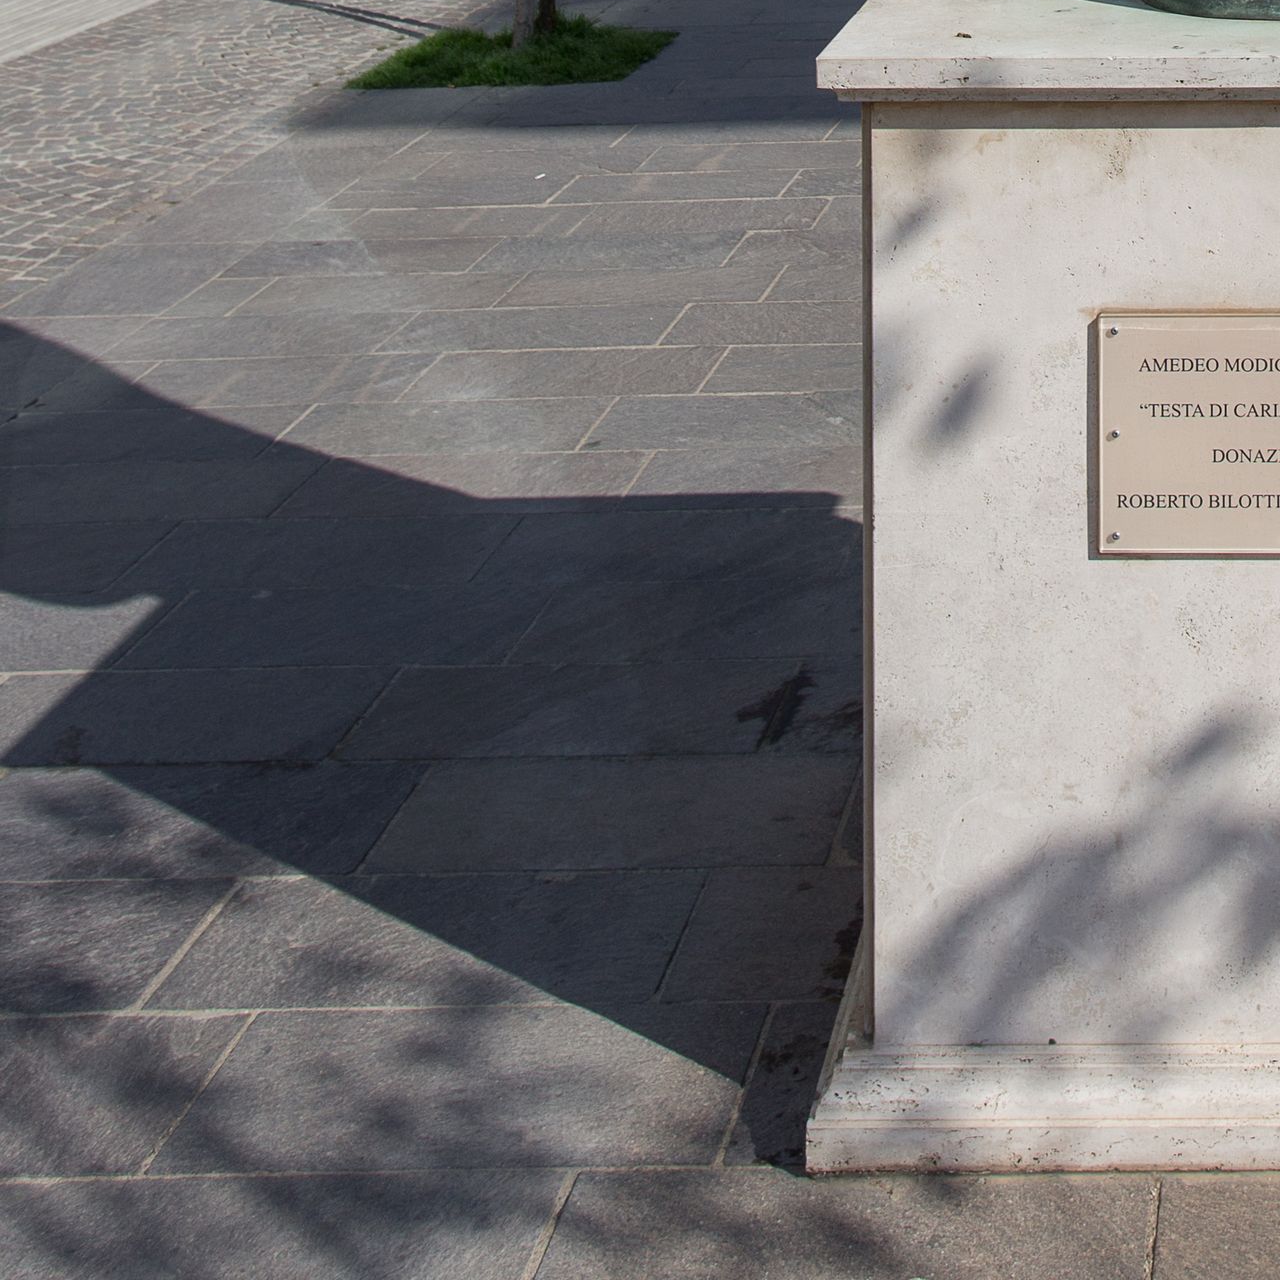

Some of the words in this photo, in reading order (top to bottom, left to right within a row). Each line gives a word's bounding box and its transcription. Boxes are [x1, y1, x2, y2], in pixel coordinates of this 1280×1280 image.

[1138, 357, 1220, 373] AMEDEO
[1139, 403, 1205, 418] “TESTA
[1209, 403, 1228, 418] DI
[1117, 494, 1204, 509] ROBERTO
[1208, 494, 1280, 509] BILOTTI
